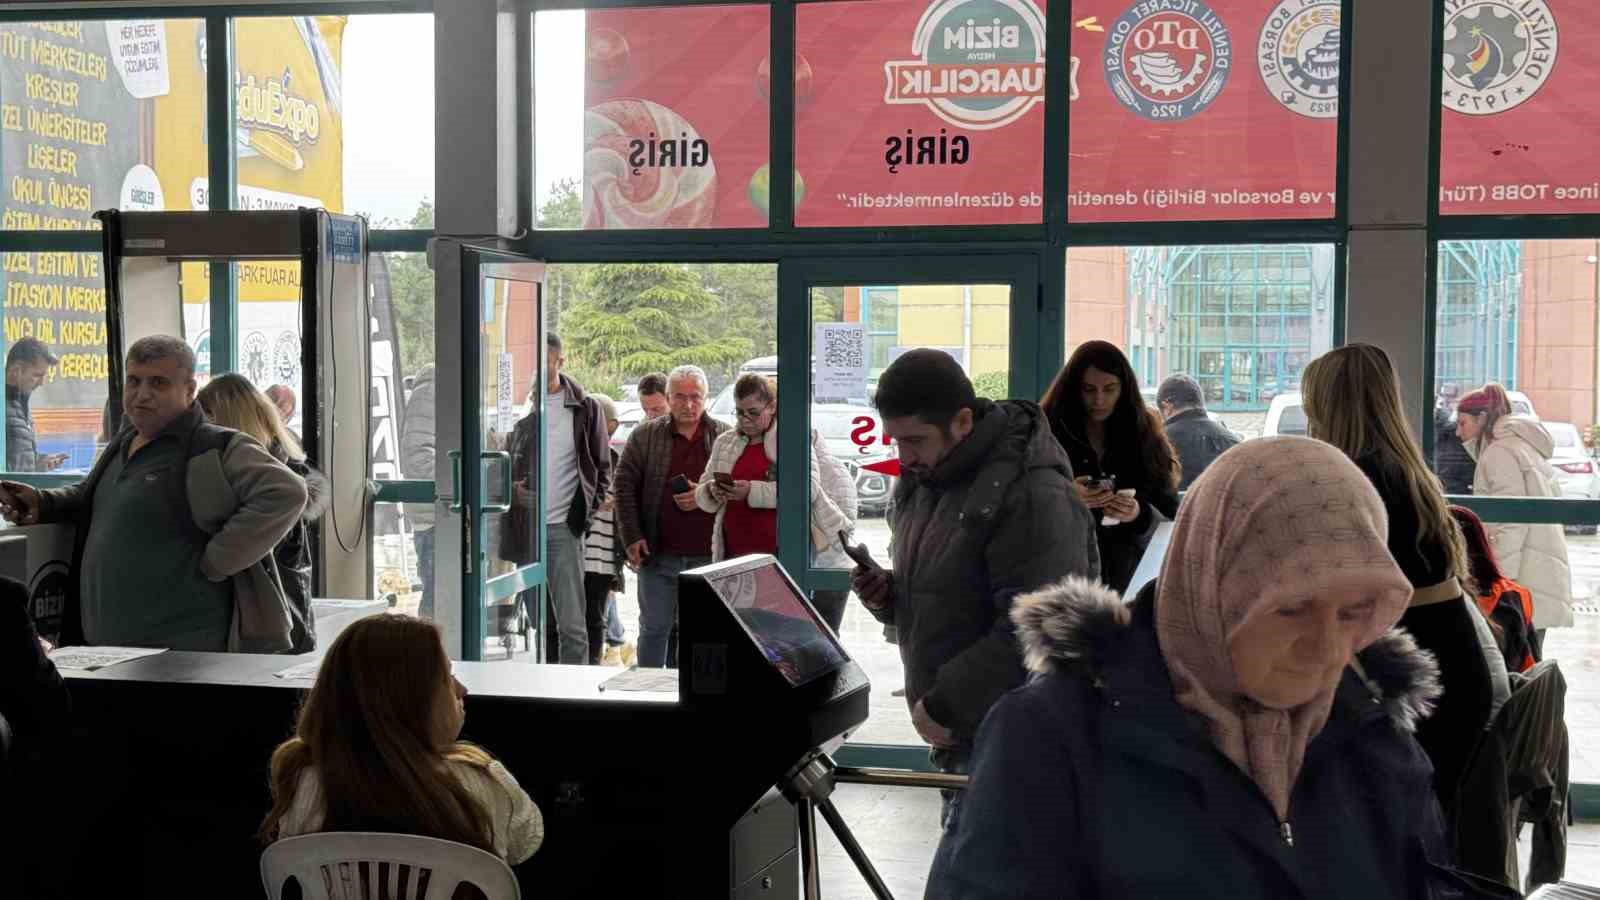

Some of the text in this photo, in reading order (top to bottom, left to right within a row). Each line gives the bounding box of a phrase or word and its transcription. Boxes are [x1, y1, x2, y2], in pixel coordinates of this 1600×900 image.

[26, 72, 79, 108] KREŞLER
[236, 73, 320, 142] duExpo
[28, 144, 77, 177] LİSELER
[13, 176, 45, 206] OKUL
[81, 252, 98, 277] VE
[259, 266, 286, 286] FUAR
